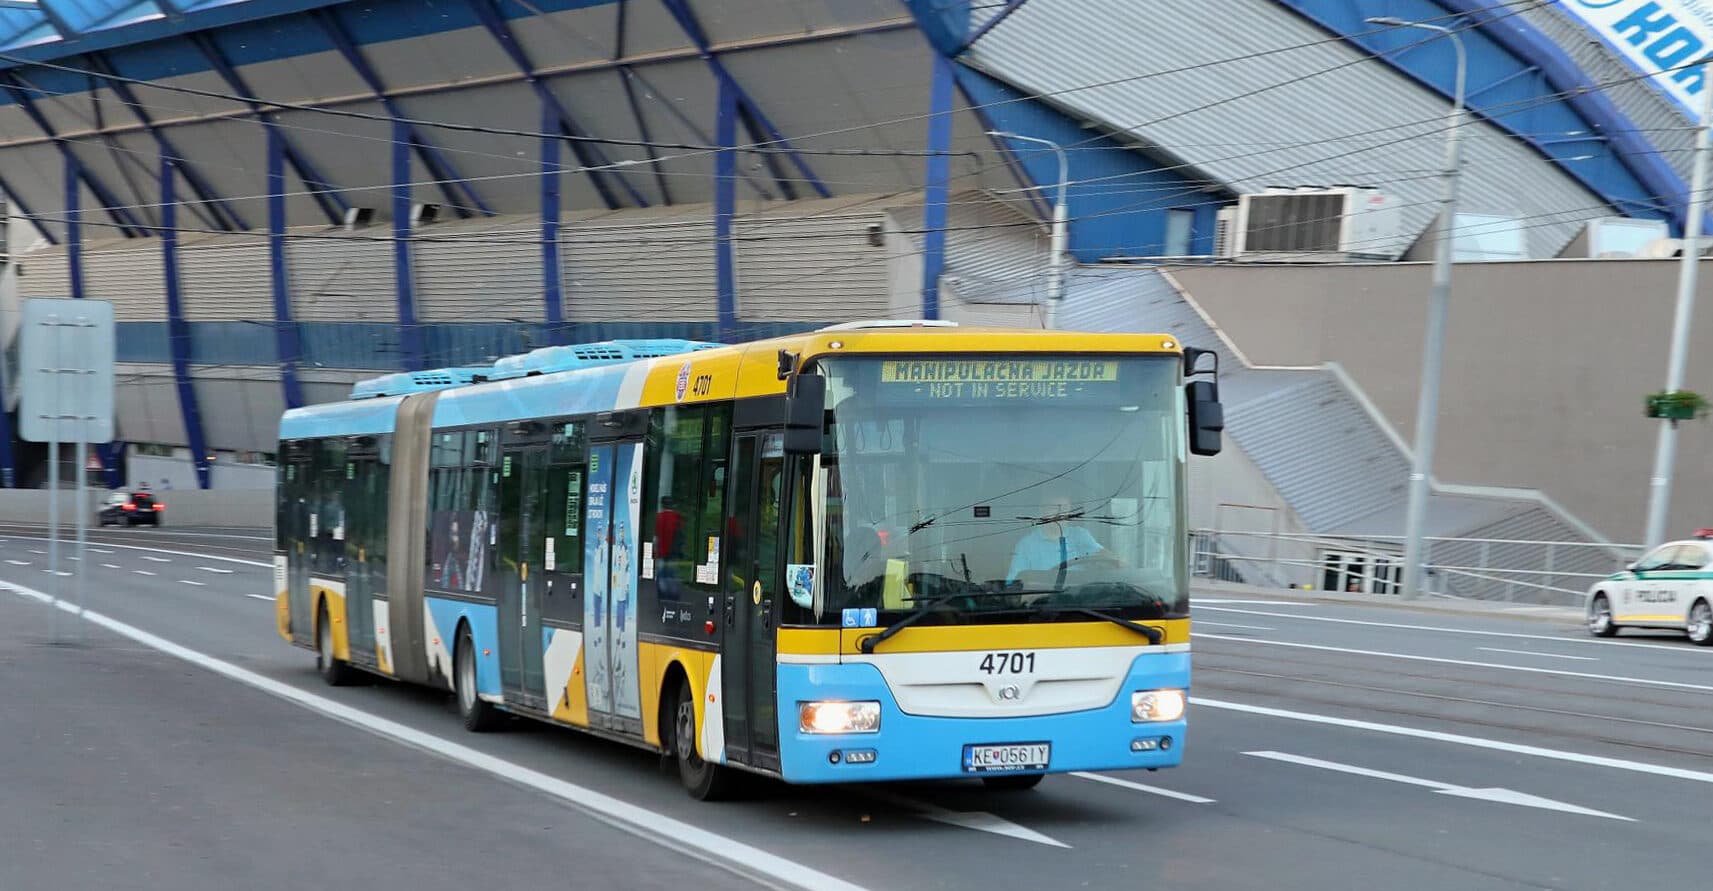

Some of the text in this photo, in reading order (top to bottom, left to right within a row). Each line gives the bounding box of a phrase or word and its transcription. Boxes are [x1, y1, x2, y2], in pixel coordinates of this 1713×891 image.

[1042, 361, 1105, 380] JAZDA
[693, 374, 712, 396] 4701
[930, 382, 963, 398] NOT
[972, 382, 988, 398] IN
[995, 381, 1067, 398] SERVICE
[979, 652, 1036, 675] 4701
[974, 749, 992, 765] KE
